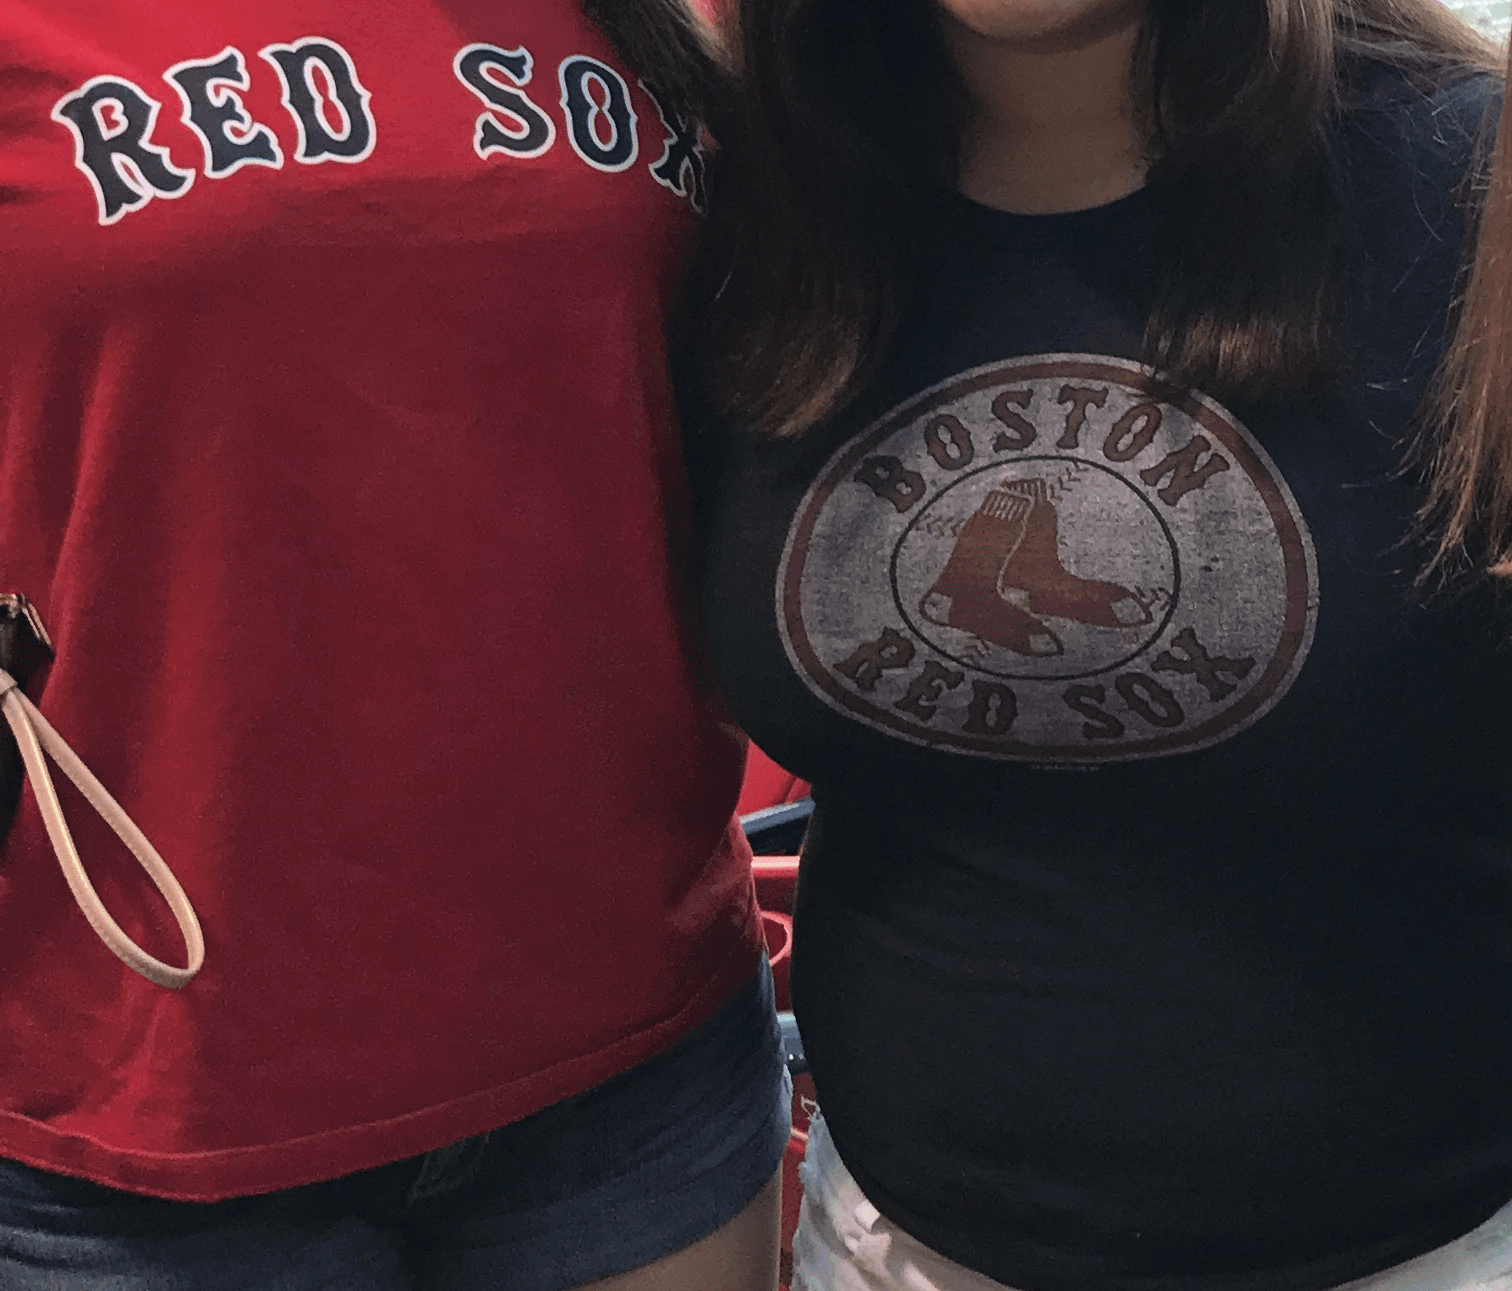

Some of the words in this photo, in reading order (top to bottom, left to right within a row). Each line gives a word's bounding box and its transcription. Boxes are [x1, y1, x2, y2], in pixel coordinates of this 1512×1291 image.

[50, 35, 377, 227] RED
[853, 384, 1230, 513] BOSTON
[832, 627, 1019, 737] RED
[1063, 627, 1256, 741] SOX
